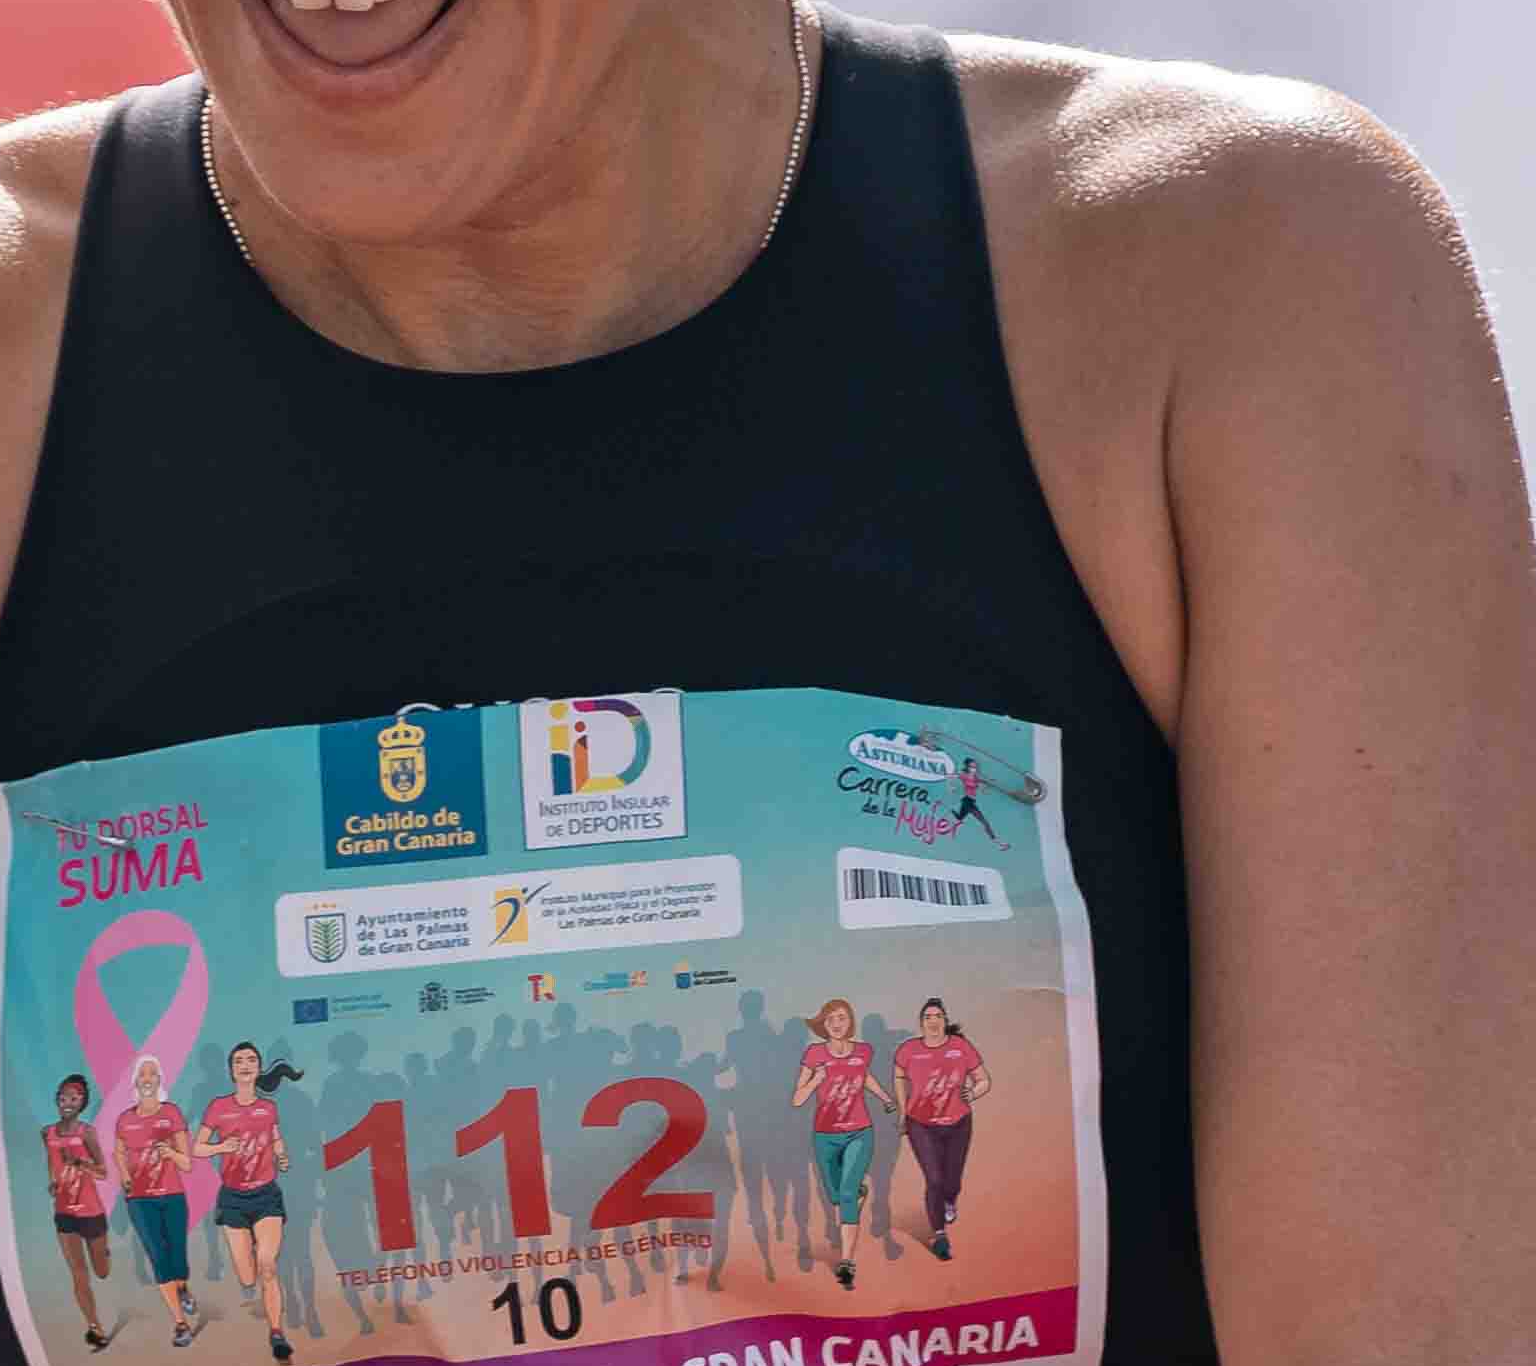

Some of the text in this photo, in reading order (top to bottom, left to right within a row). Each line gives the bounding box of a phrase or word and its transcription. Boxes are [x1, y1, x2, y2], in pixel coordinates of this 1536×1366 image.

[855, 741, 948, 776] ASTURIANA
[837, 766, 931, 804] Carrera
[344, 807, 461, 836] Cabildo de
[538, 795, 671, 817] INSTITUTO INSULAR
[862, 798, 897, 818] de la
[96, 802, 209, 847] DORSAL
[546, 812, 664, 837] DE DEPORTES
[894, 799, 965, 845] Mujer
[335, 828, 477, 856] Gran Canaria
[56, 837, 204, 907] SUMA
[356, 906, 468, 927] Ayuntamiento
[357, 922, 470, 942] de Las Palmas
[358, 936, 472, 956] de Gran Canaria
[322, 1077, 716, 1252] 112
[456, 1247, 582, 1275] VIOLENCIA
[586, 1242, 619, 1261] DE
[491, 1278, 584, 1346] 10
